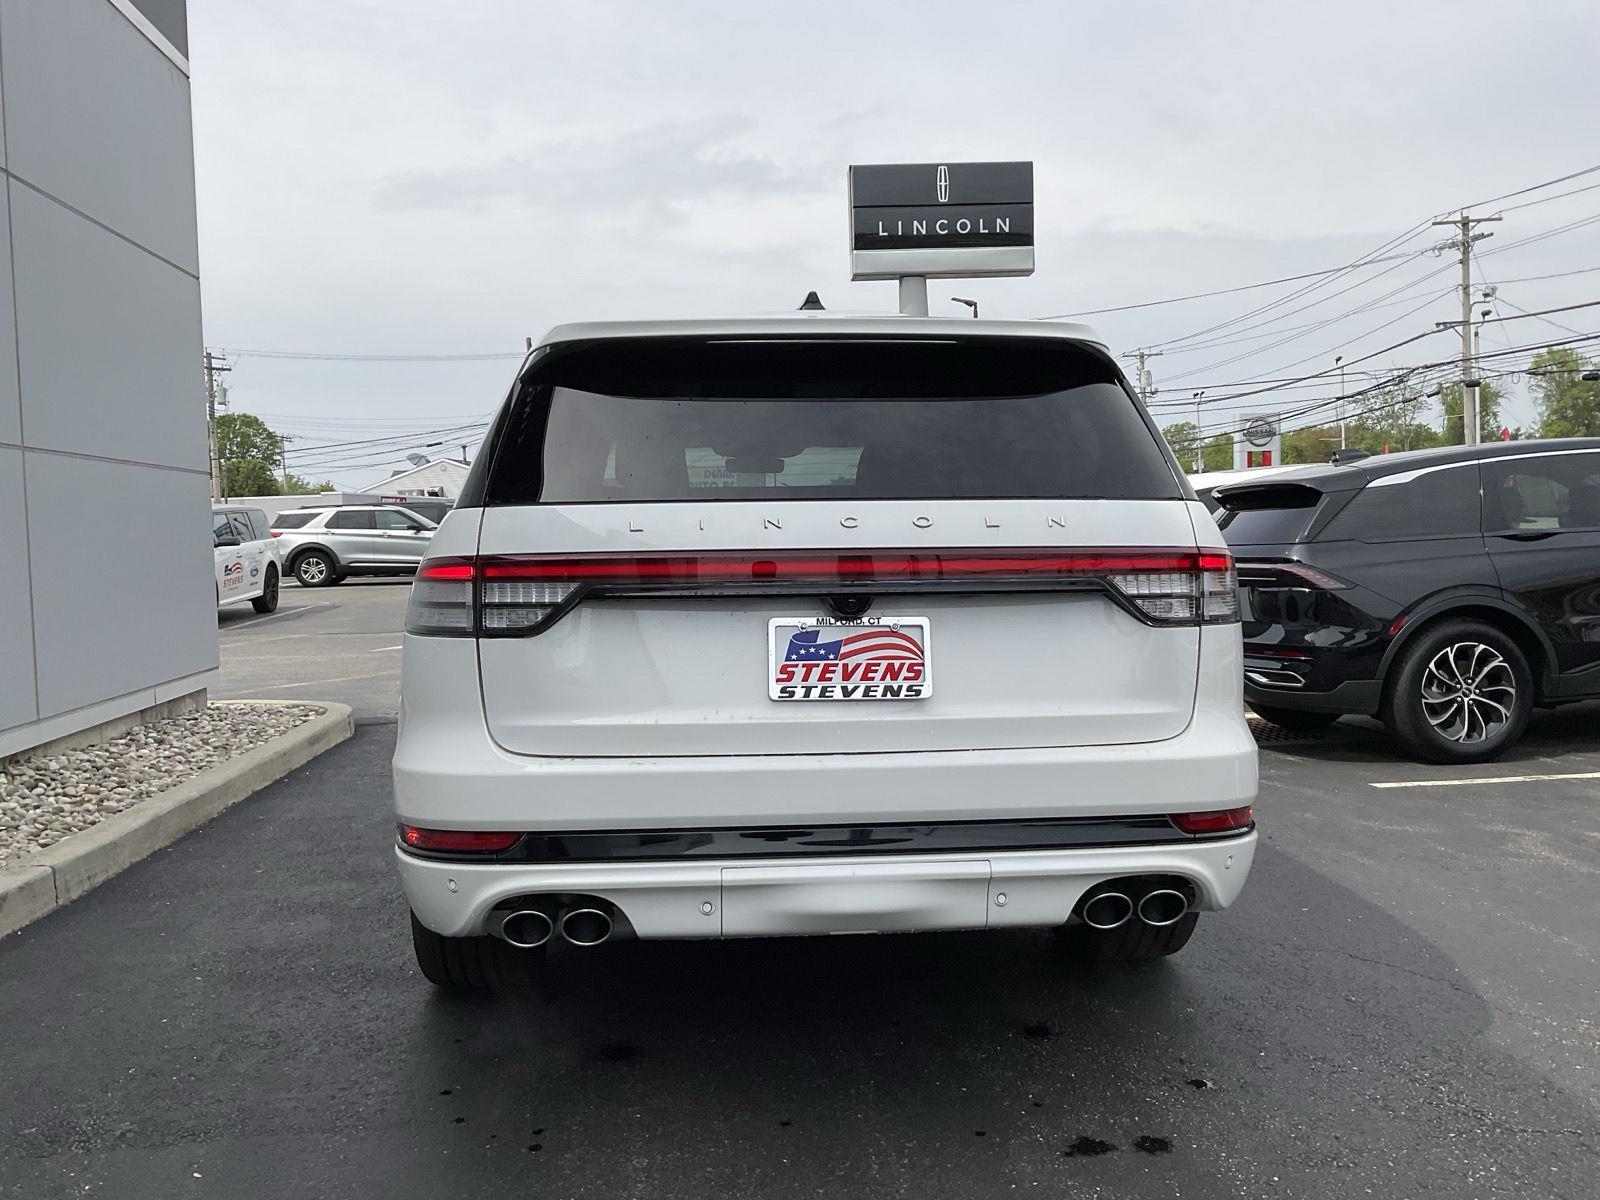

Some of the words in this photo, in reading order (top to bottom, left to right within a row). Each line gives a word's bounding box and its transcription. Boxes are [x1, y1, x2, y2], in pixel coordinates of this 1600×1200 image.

[878, 217, 1010, 236] LINCOLN
[1246, 427, 1274, 436] NISSAN
[628, 514, 1066, 533] LINCOLN
[867, 616, 882, 625] CT
[775, 661, 925, 683] STEVENS
[777, 684, 924, 699] STEVENS
